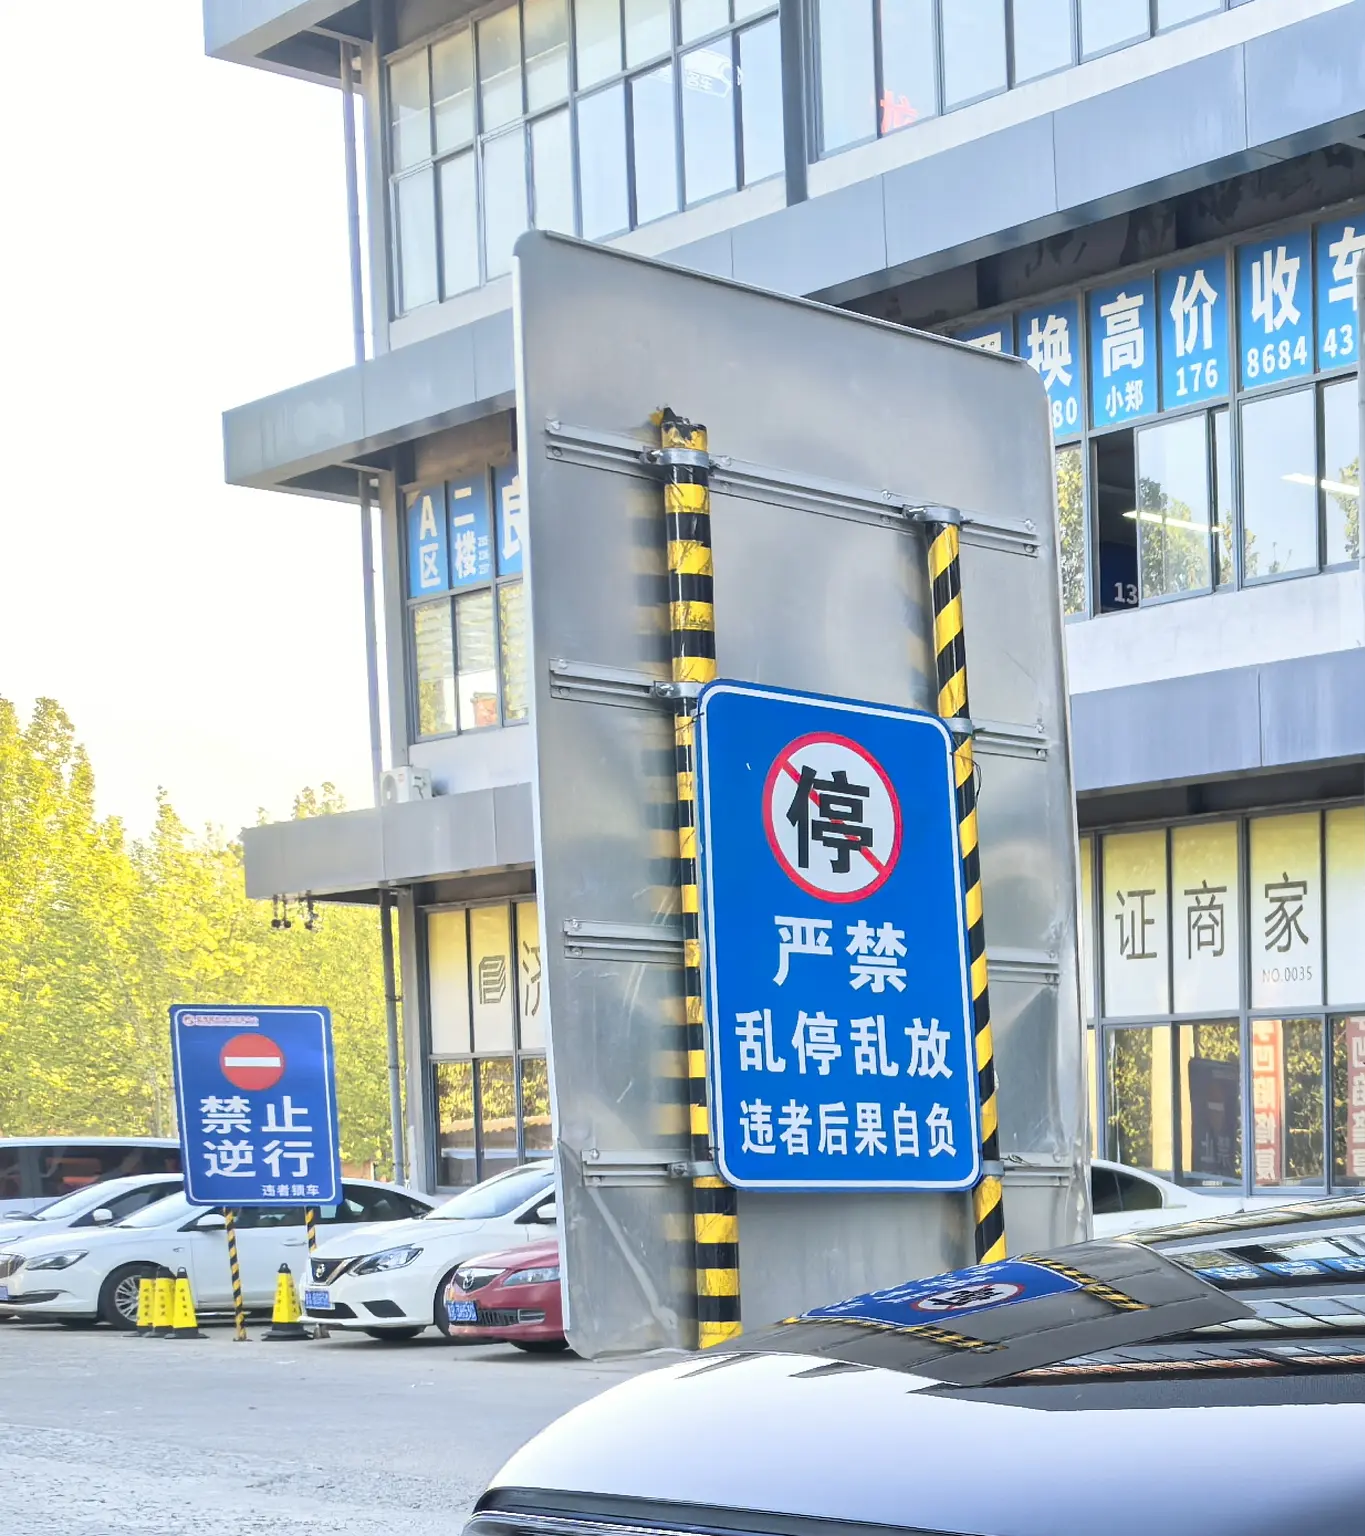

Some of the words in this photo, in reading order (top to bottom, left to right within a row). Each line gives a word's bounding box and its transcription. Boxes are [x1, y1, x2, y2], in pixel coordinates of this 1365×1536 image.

[1105, 379, 1144, 418] 小郑
[1175, 359, 1219, 396] 176
[1247, 336, 1307, 378] 8684
[786, 763, 874, 874] 停
[1115, 872, 1310, 960] 证商家
[772, 915, 908, 993] 严禁
[734, 1008, 954, 1080] 乱停乱放
[199, 1095, 313, 1134] 禁止
[738, 1097, 958, 1159] 违者后果自负
[202, 1138, 316, 1178] 逆行
